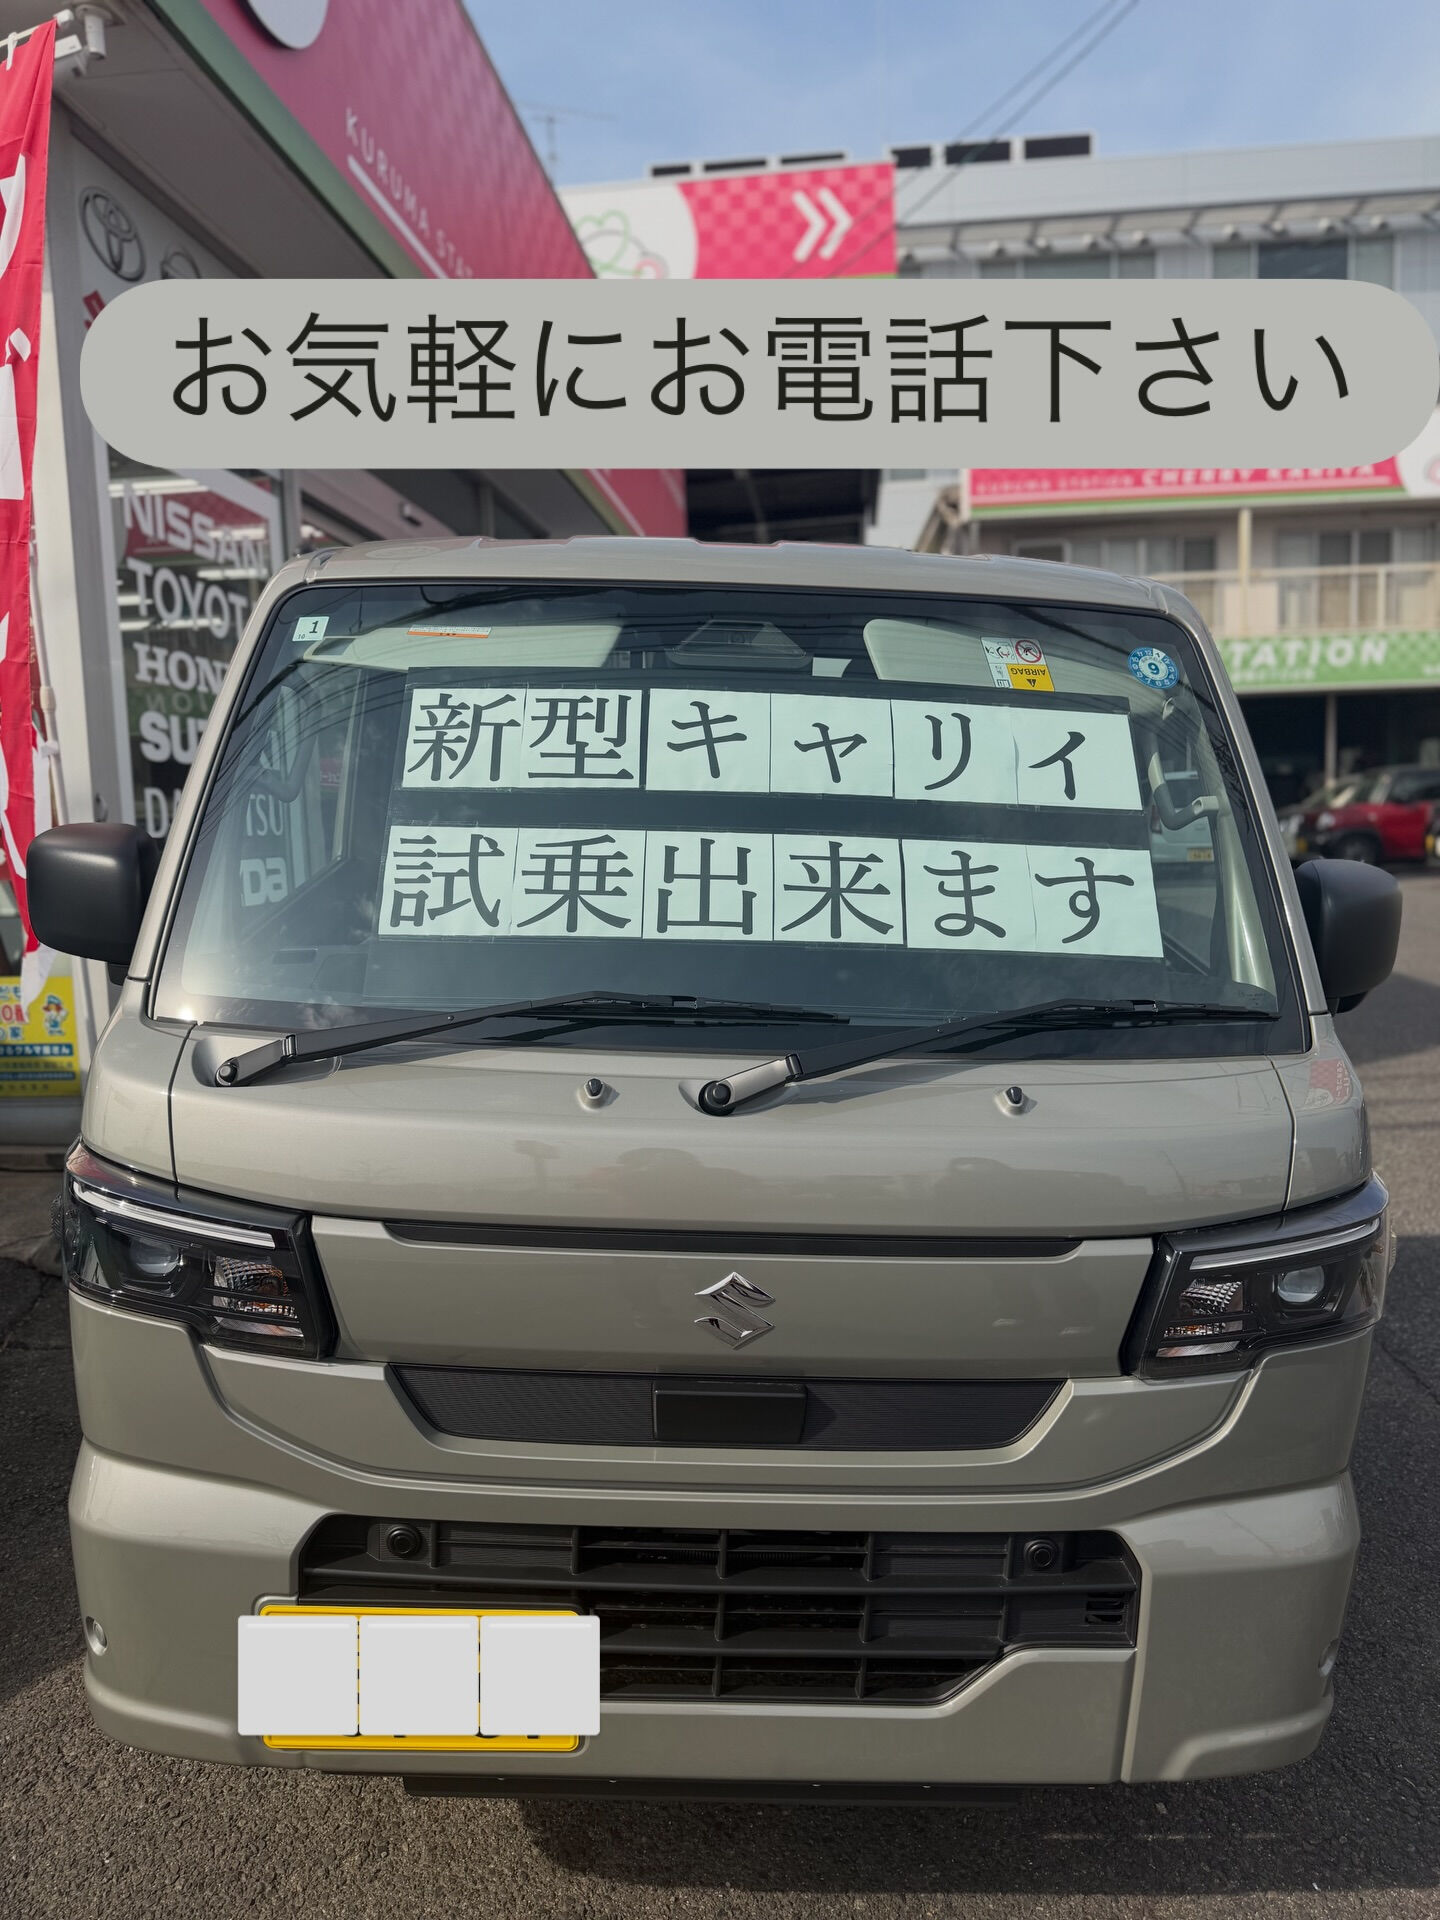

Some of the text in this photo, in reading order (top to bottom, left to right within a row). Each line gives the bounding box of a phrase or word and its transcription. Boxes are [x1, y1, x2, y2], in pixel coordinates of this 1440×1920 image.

[122, 482, 265, 571] NISSAN
[127, 556, 250, 643] TOYOT
[309, 620, 319, 633] 1
[133, 642, 230, 694] HON
[1010, 667, 1046, 676] AIRBAG
[1148, 662, 1160, 675] 9
[1229, 638, 1388, 668] TATION
[139, 711, 209, 766] SU
[391, 834, 1136, 945] 試乗出来ます
